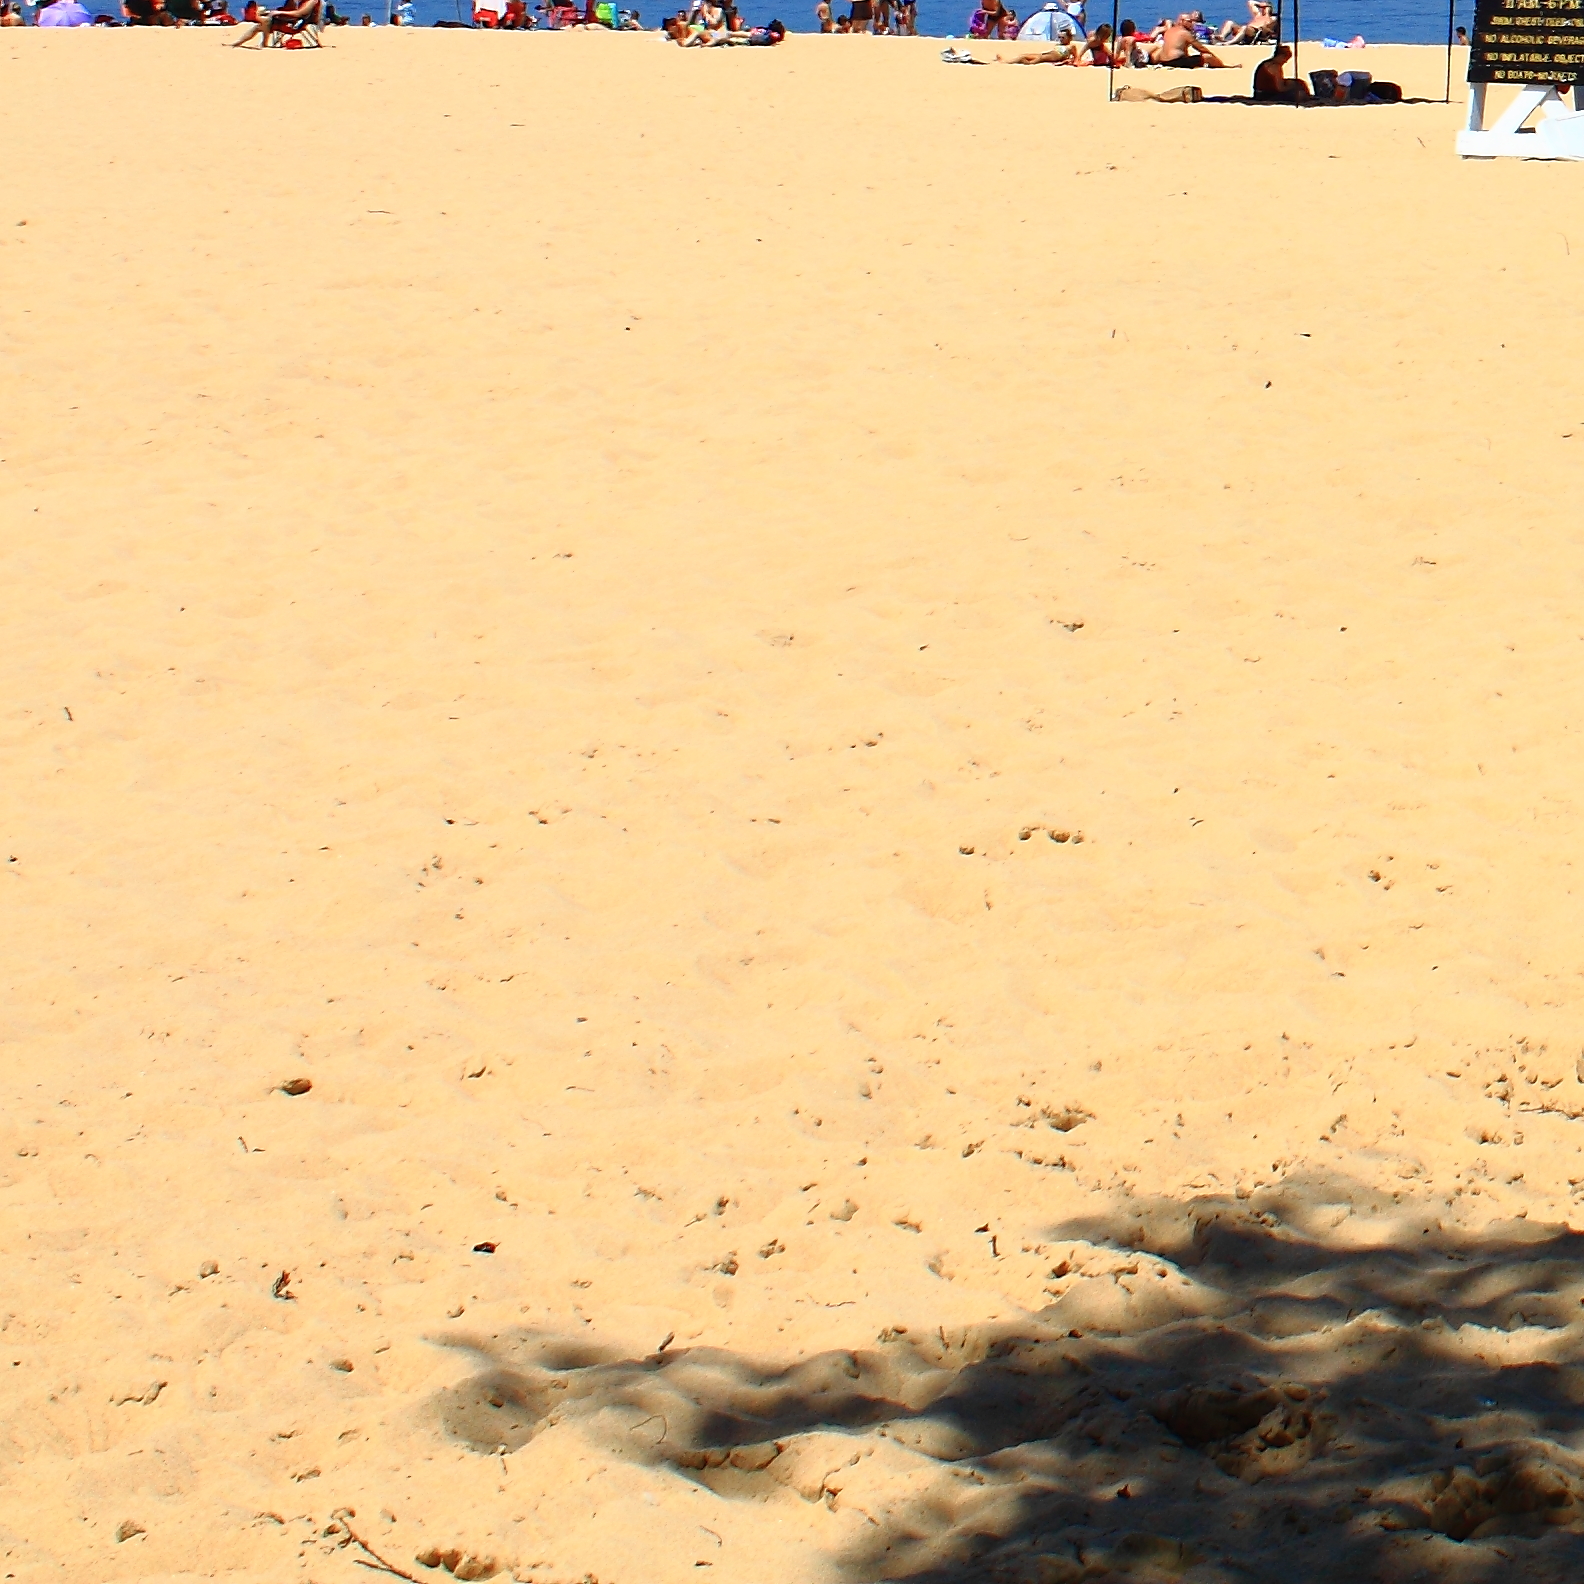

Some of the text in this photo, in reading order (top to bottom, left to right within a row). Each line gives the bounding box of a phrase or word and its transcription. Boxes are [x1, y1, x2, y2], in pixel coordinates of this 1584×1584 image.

[1485, 34, 1496, 43] NO
[1500, 34, 1544, 45] ALCOHOLIC
[1486, 52, 1498, 61] NO
[1501, 53, 1552, 63] INFLATABLE
